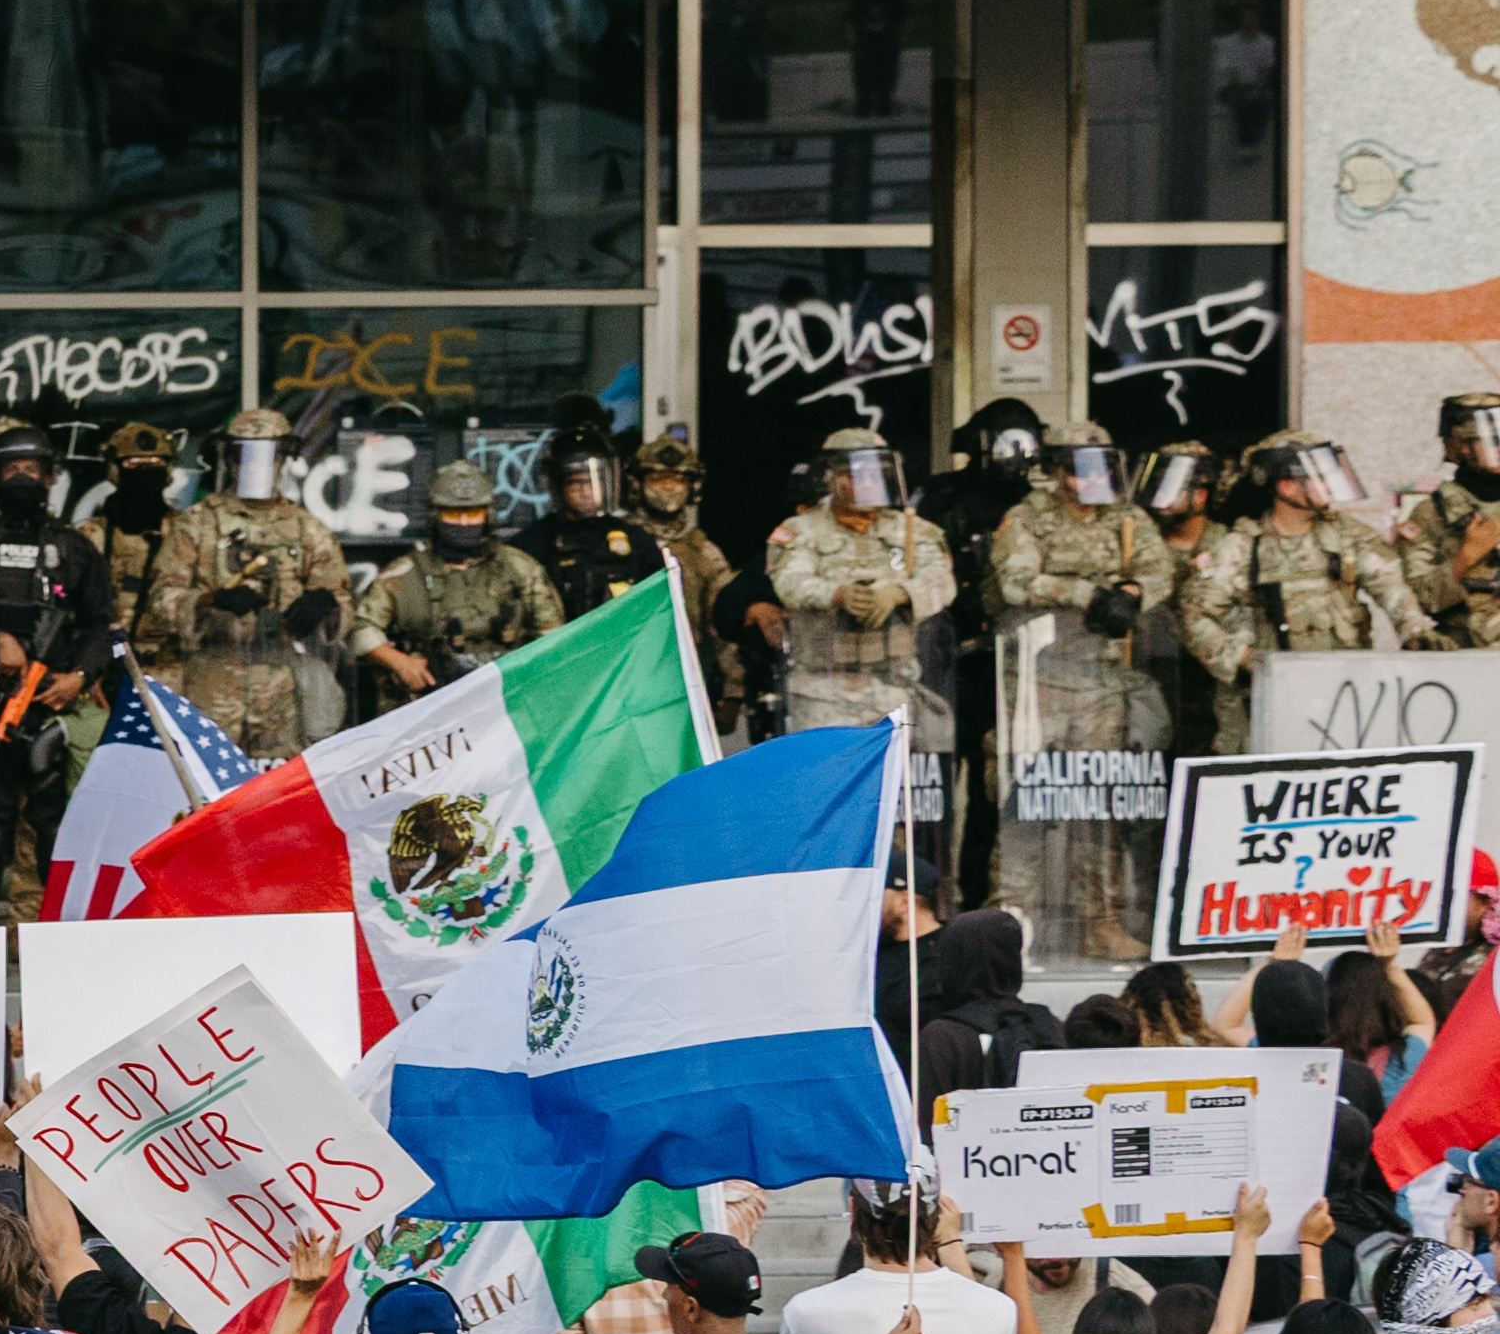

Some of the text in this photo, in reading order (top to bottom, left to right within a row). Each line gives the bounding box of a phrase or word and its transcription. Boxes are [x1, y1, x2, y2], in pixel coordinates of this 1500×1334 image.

[274, 328, 478, 396] ICE
[1016, 750, 1167, 787] CALIFORNIA
[1017, 786, 1167, 821] NATIONAL GUARD
[1243, 774, 1401, 824] WHERE
[1239, 827, 1396, 866] IS YOUR
[1199, 866, 1432, 936] Humanity
[33, 1007, 255, 1182] PEOPLE
[1022, 1107, 1092, 1121] FP-P150-PP
[1109, 1101, 1150, 1114] Karat
[143, 1111, 263, 1192] OVER
[963, 1141, 1077, 1178] Karat
[164, 1138, 384, 1306] PAPERS
[1038, 1221, 1073, 1231] Portion
